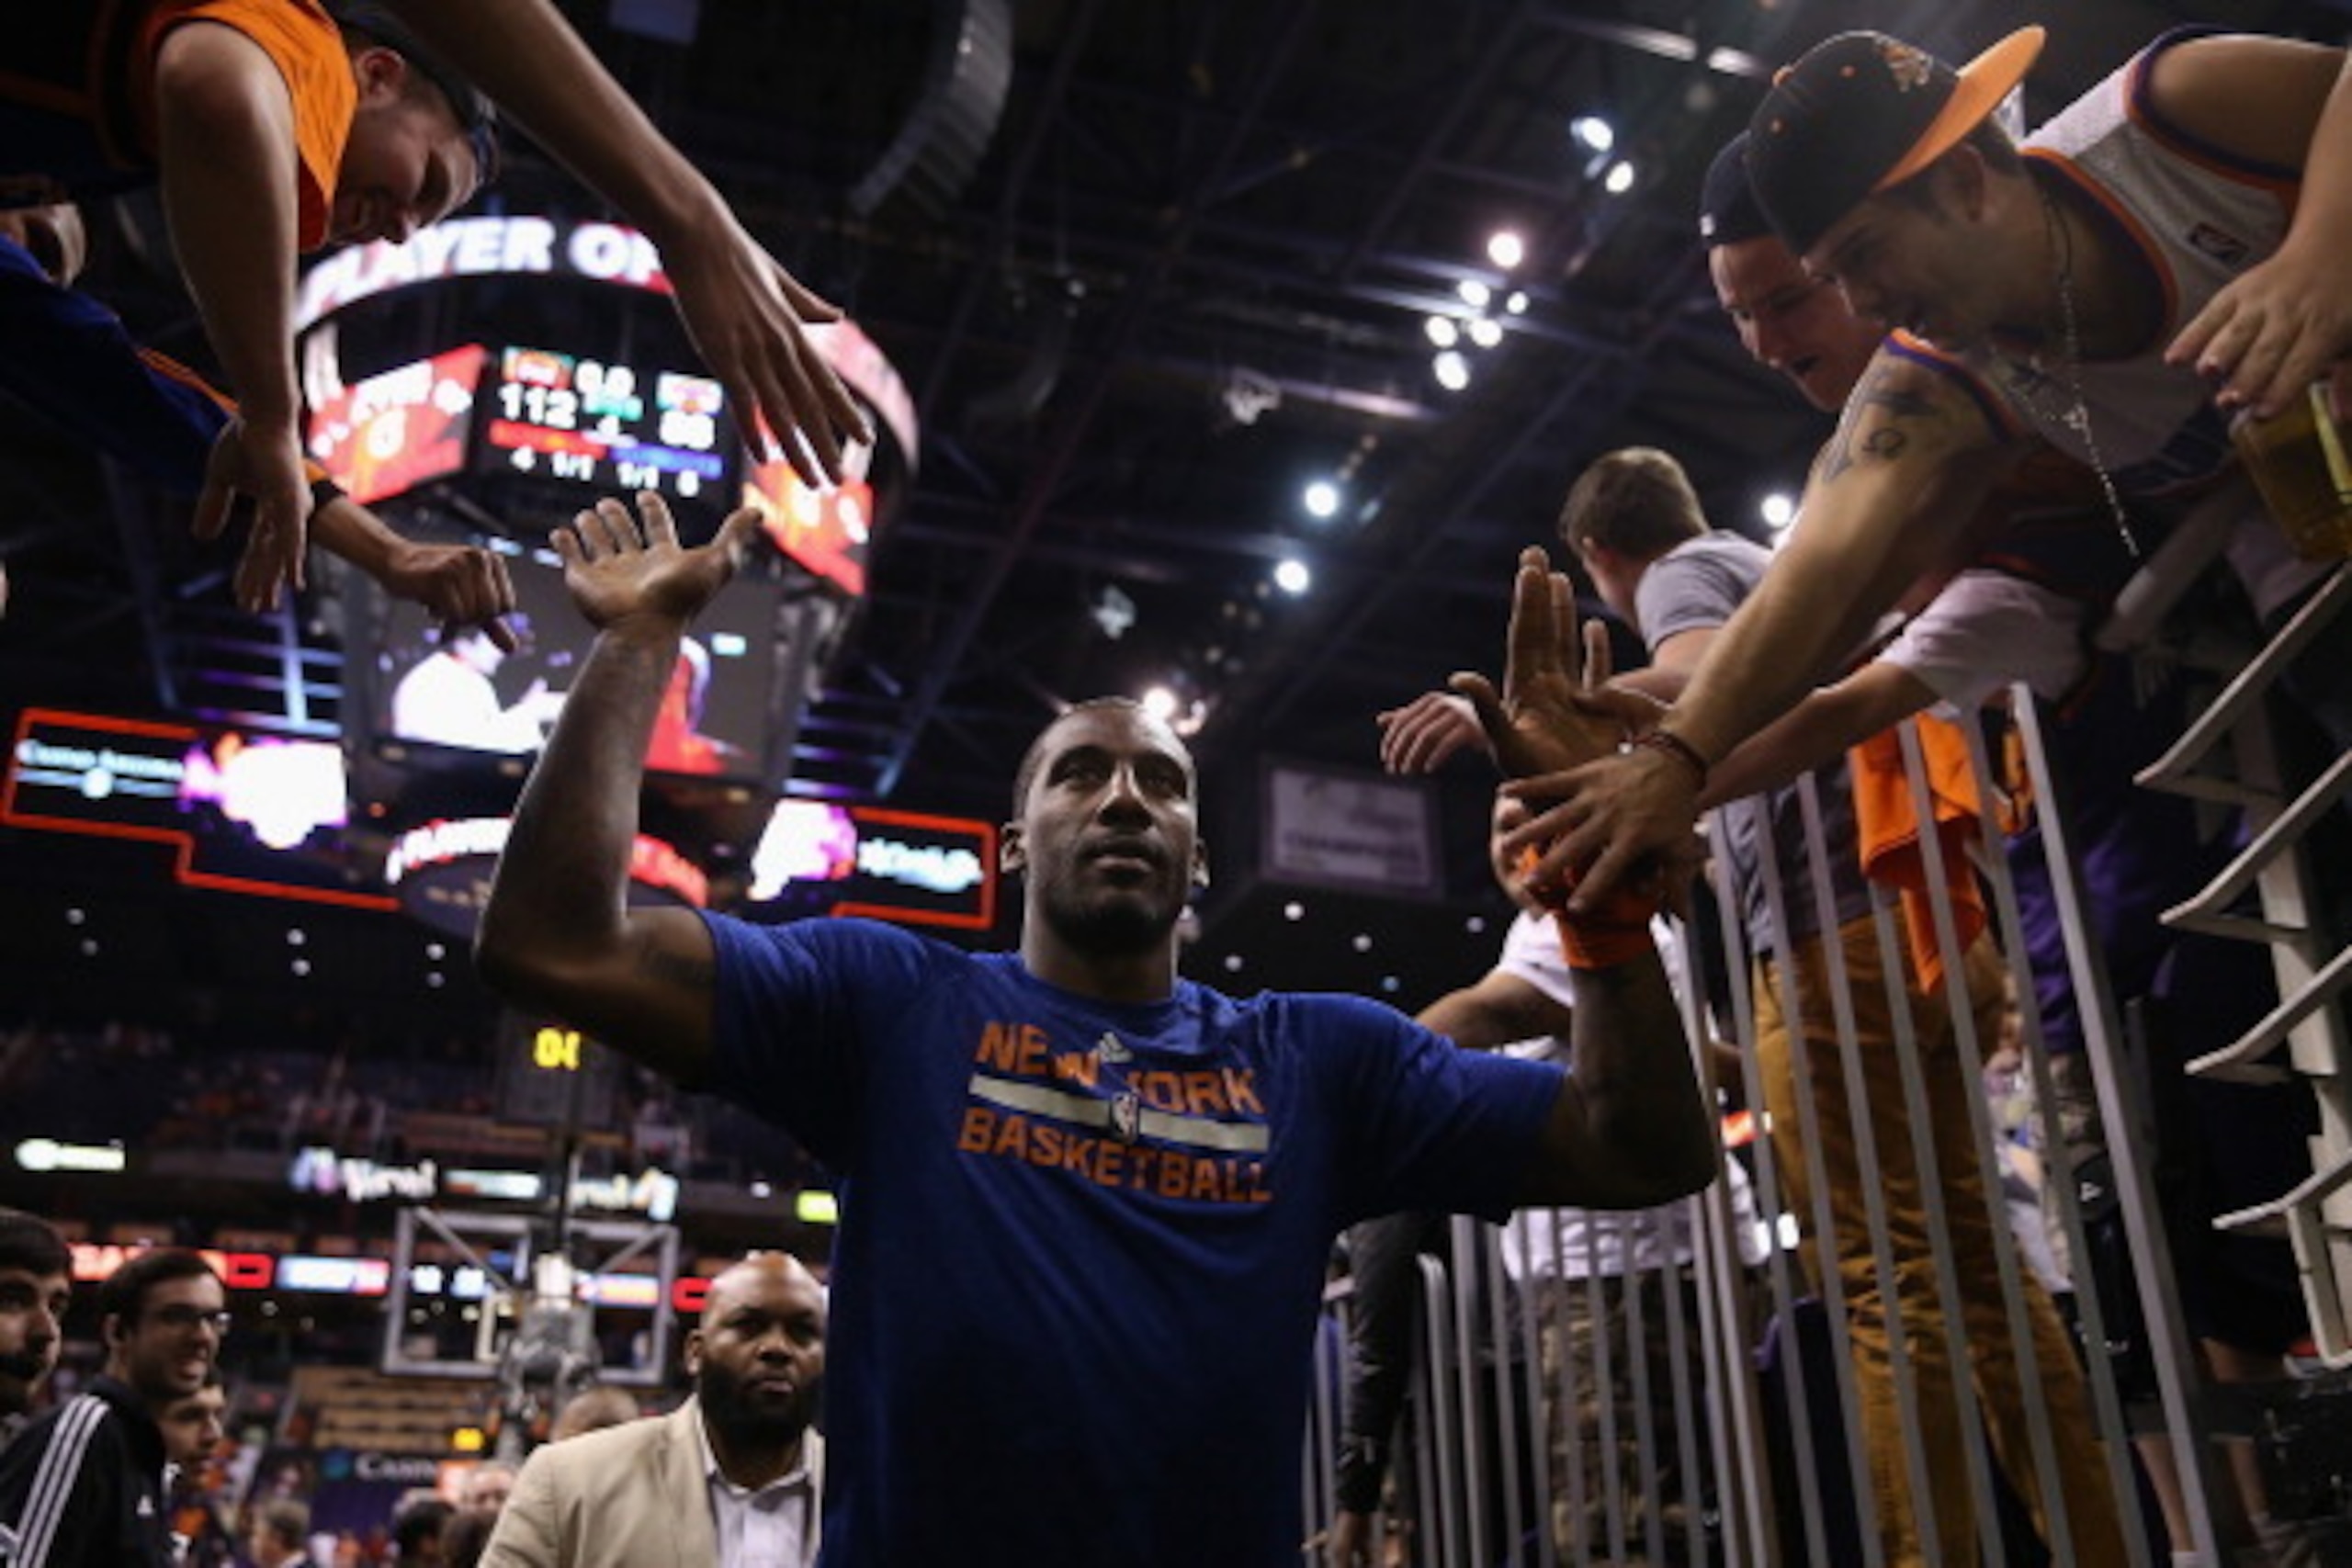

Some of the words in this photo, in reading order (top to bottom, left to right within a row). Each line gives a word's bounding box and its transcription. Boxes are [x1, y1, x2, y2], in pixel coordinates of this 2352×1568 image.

[498, 382, 579, 429] 112
[976, 1021, 1100, 1087] NEW
[957, 1106, 1272, 1202] BASKETBALL
